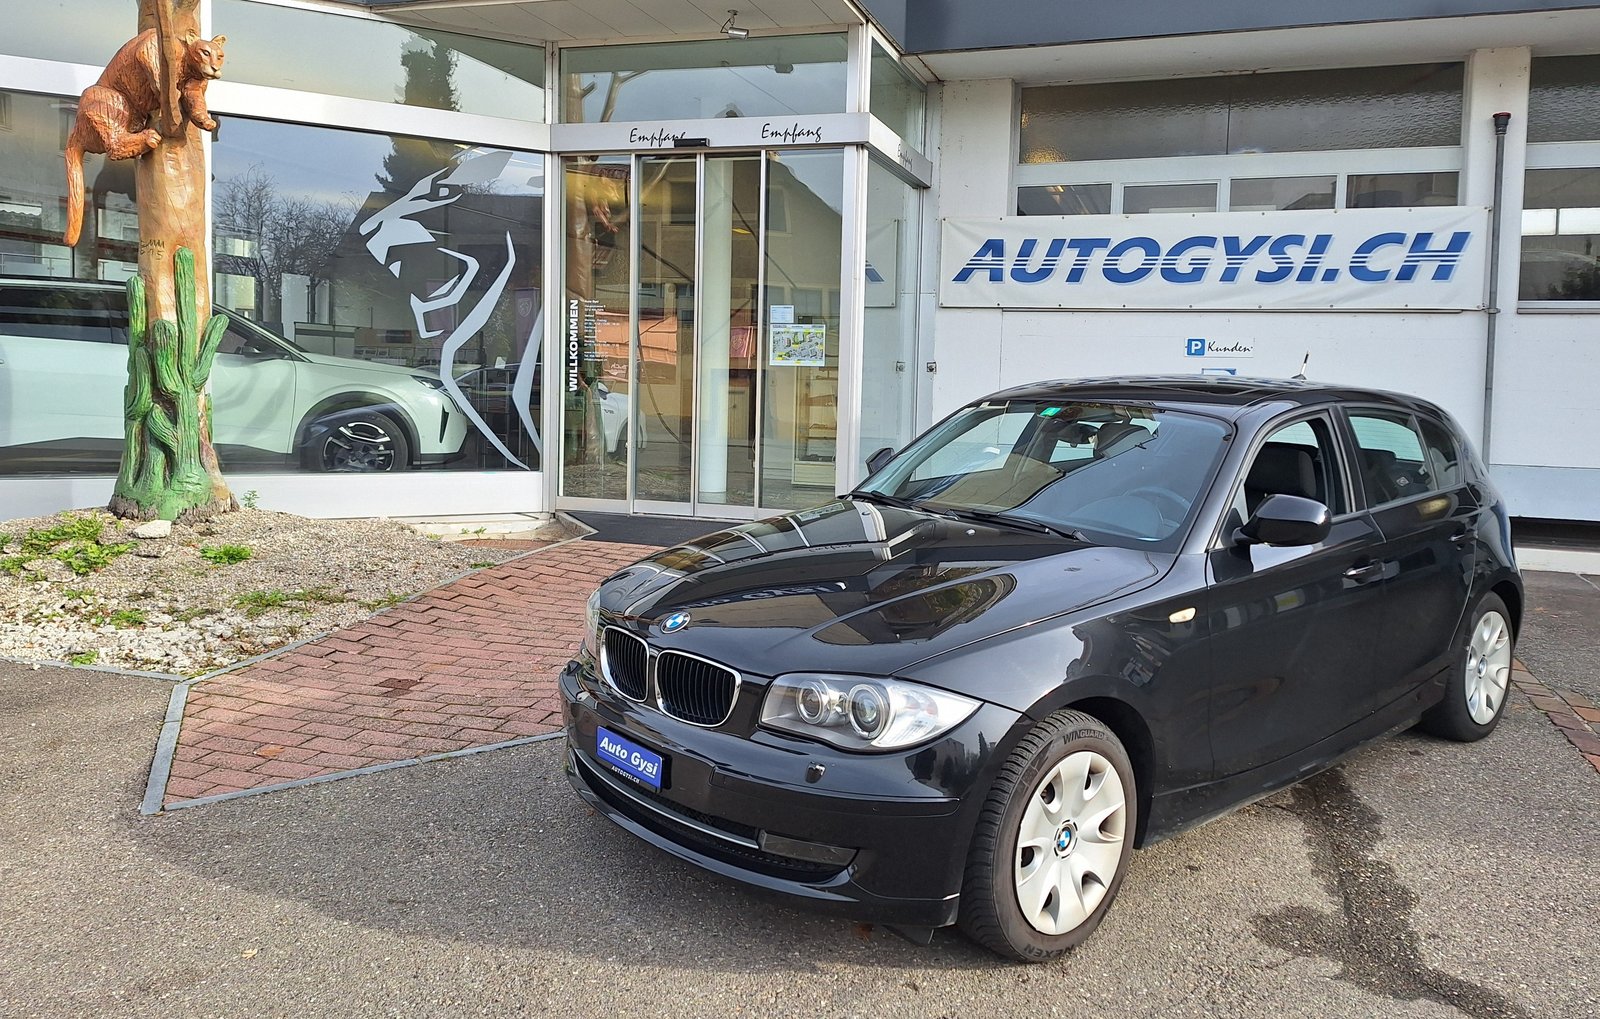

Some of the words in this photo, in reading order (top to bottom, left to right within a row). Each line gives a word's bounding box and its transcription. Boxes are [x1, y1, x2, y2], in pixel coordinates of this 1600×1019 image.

[761, 123, 822, 143] Empfang
[952, 231, 1473, 283] AUTOGYSI.CH
[569, 299, 579, 392] WILLKOMMEN
[1191, 340, 1202, 354] P
[1062, 728, 1105, 745] WINGUARD
[599, 737, 628, 759] Auto
[631, 752, 658, 776] Gysi
[1023, 943, 1075, 959] NEXEN
